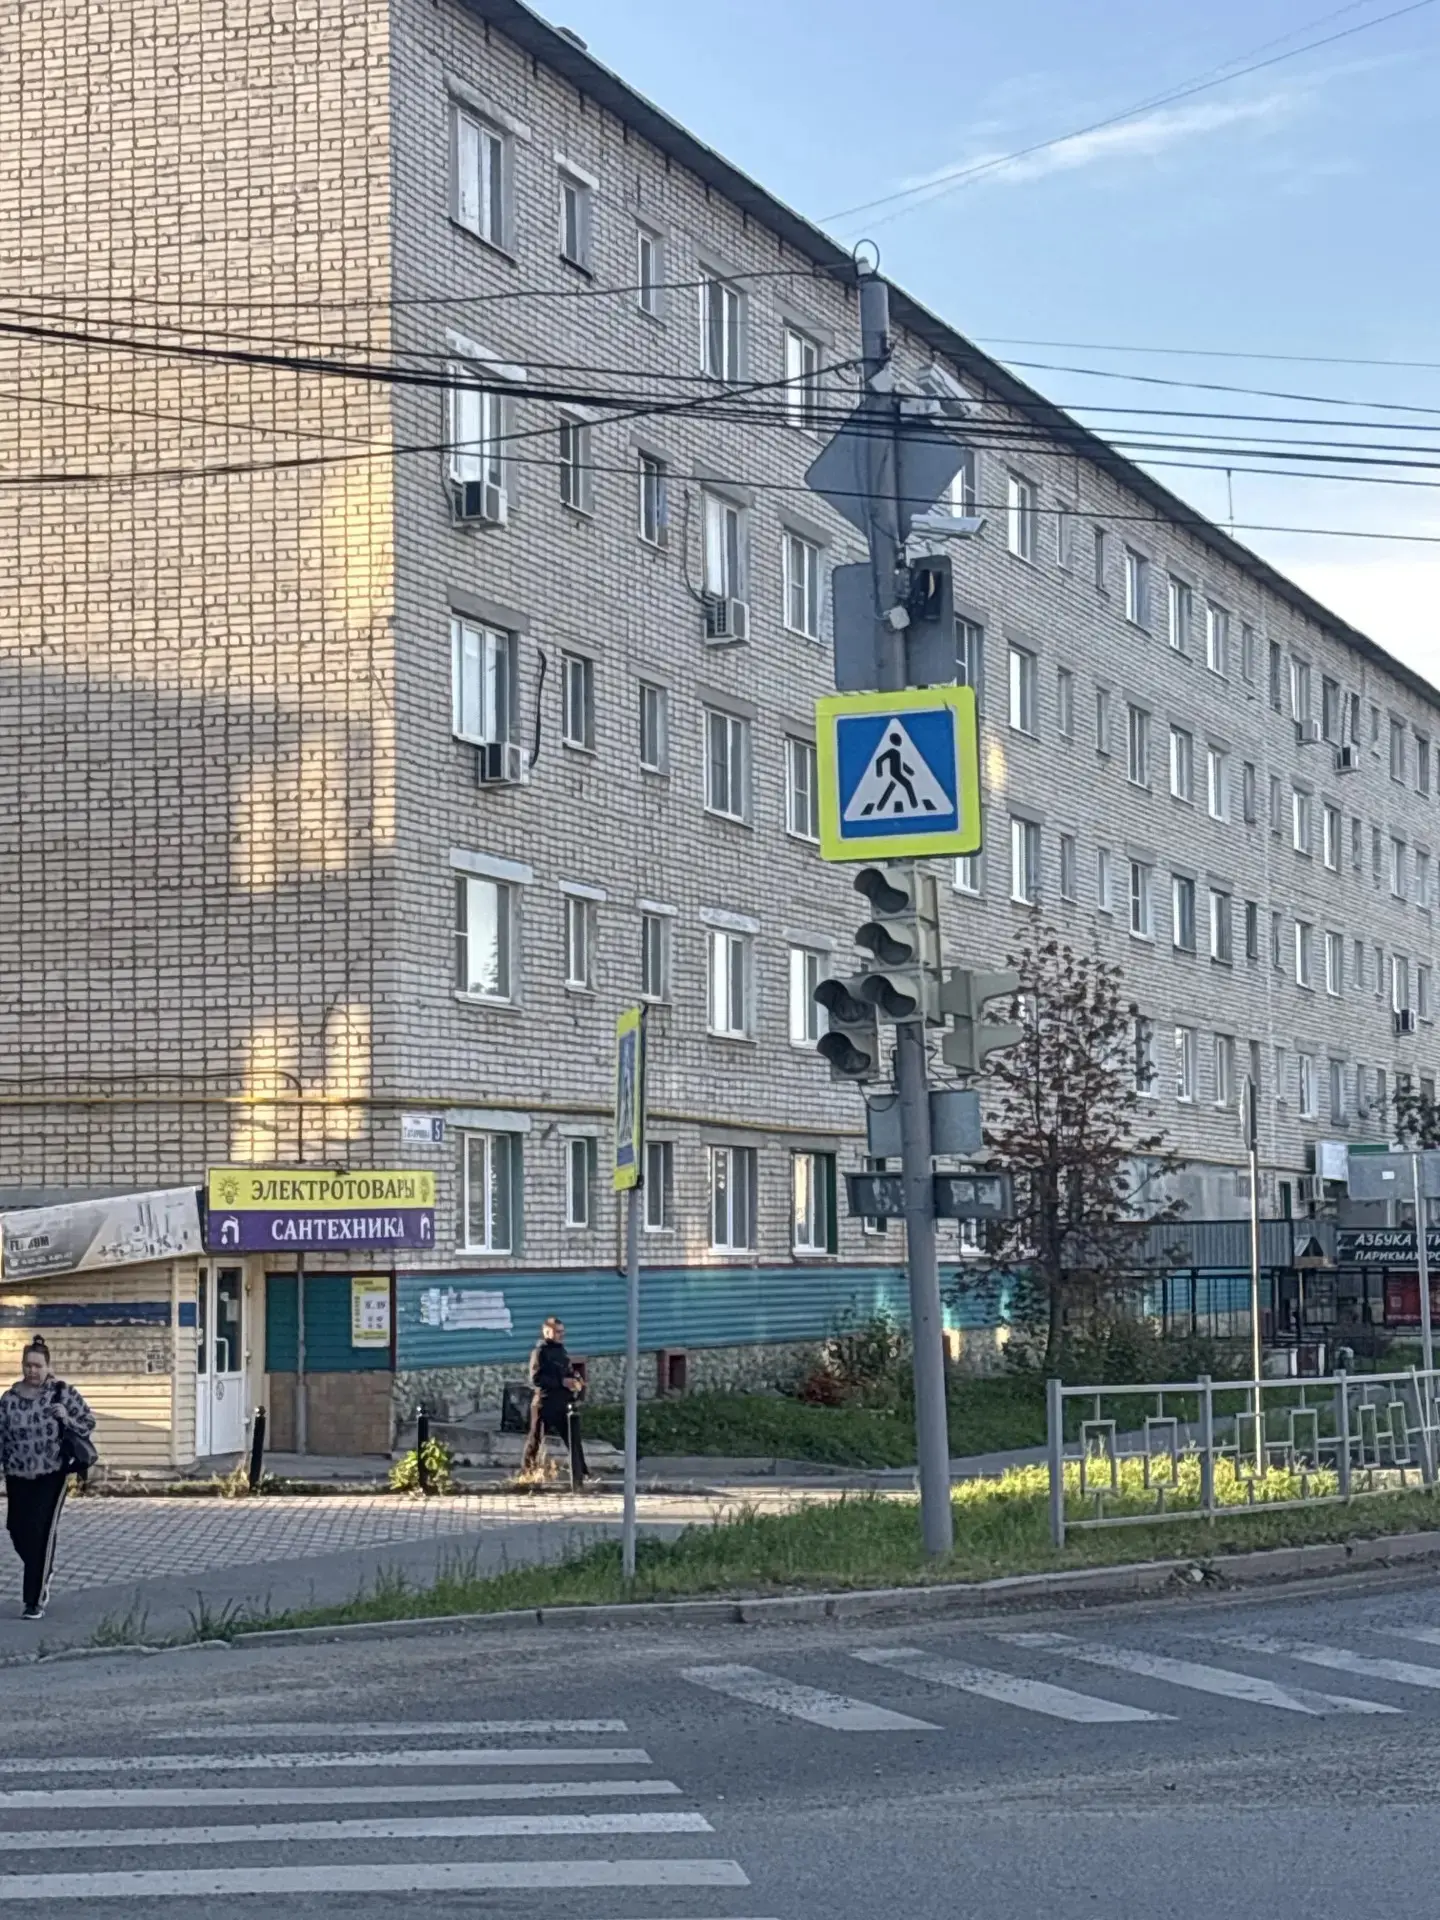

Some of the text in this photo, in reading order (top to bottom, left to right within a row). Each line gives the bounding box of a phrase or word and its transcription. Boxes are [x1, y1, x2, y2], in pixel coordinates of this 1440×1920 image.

[251, 1178, 415, 1200] ЭЛЕКТРОТОВАРЫ
[271, 1217, 404, 1240] САНТЕХНИКА
[1354, 1233, 1411, 1246] АЗБУКА
